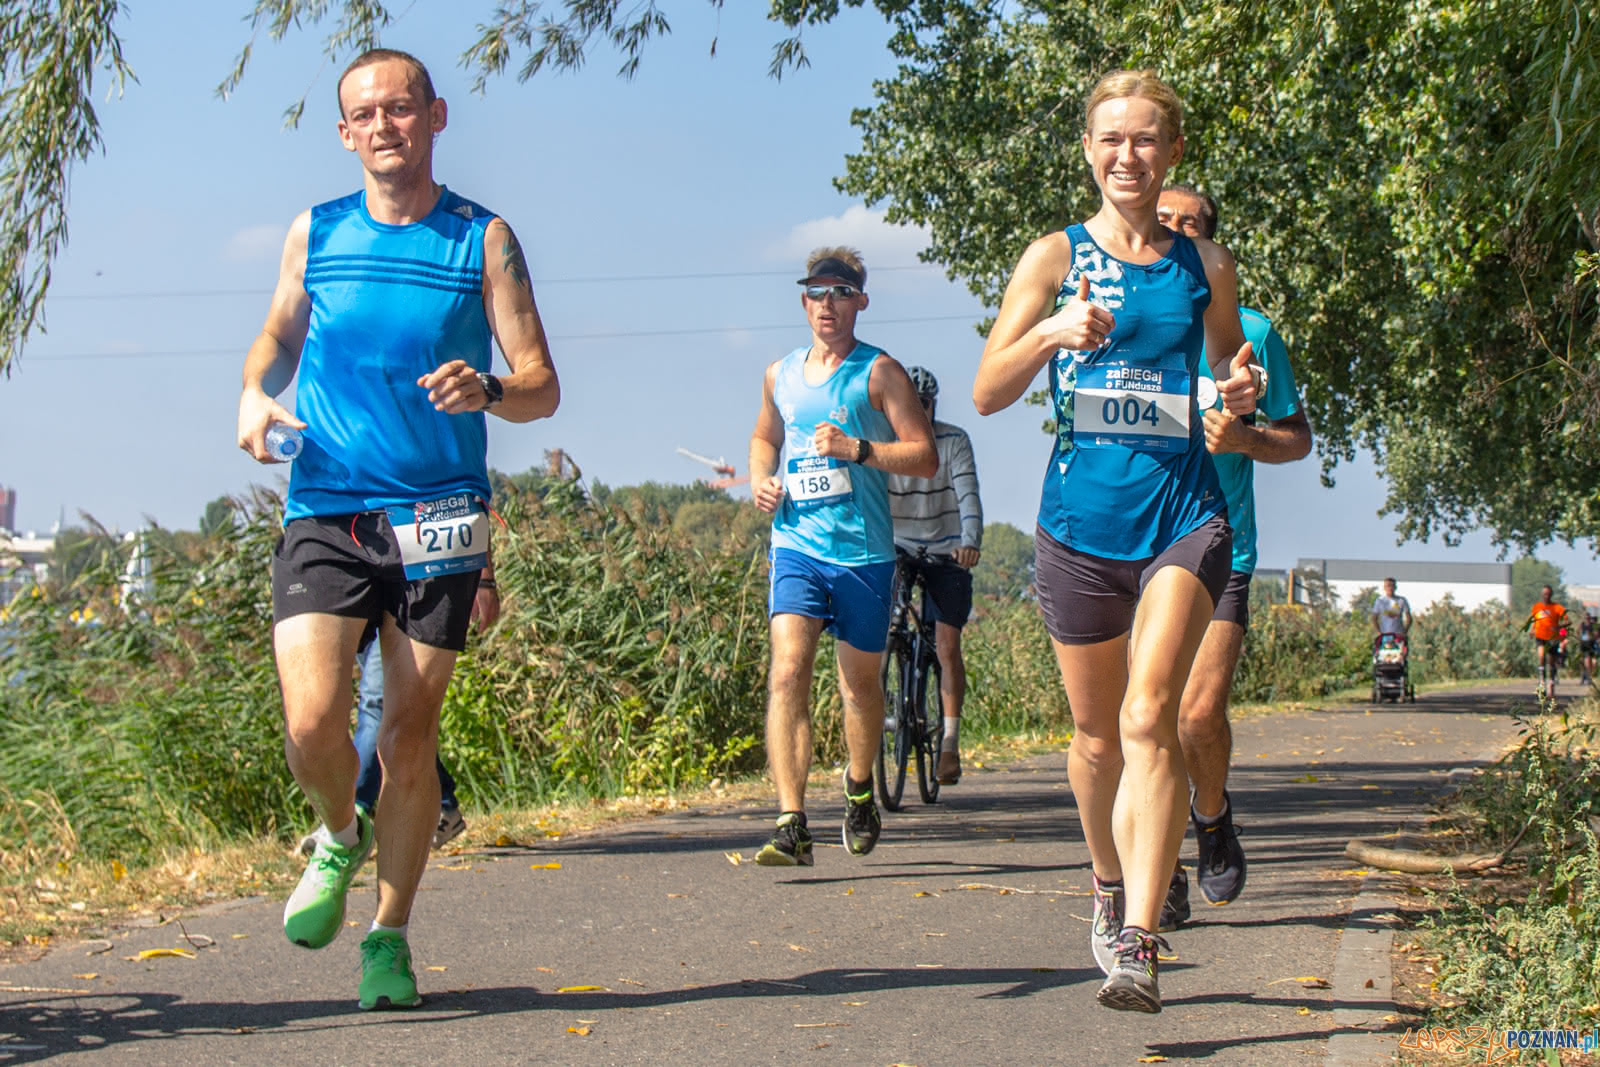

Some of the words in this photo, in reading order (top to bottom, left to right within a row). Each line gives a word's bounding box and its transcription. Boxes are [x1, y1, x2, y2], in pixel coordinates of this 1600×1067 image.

[1105, 367, 1162, 384] zaBIEGaj
[1115, 380, 1162, 392] FUNdusze
[1102, 397, 1160, 427] 004
[800, 475, 830, 494] 158
[422, 523, 472, 553] 270
